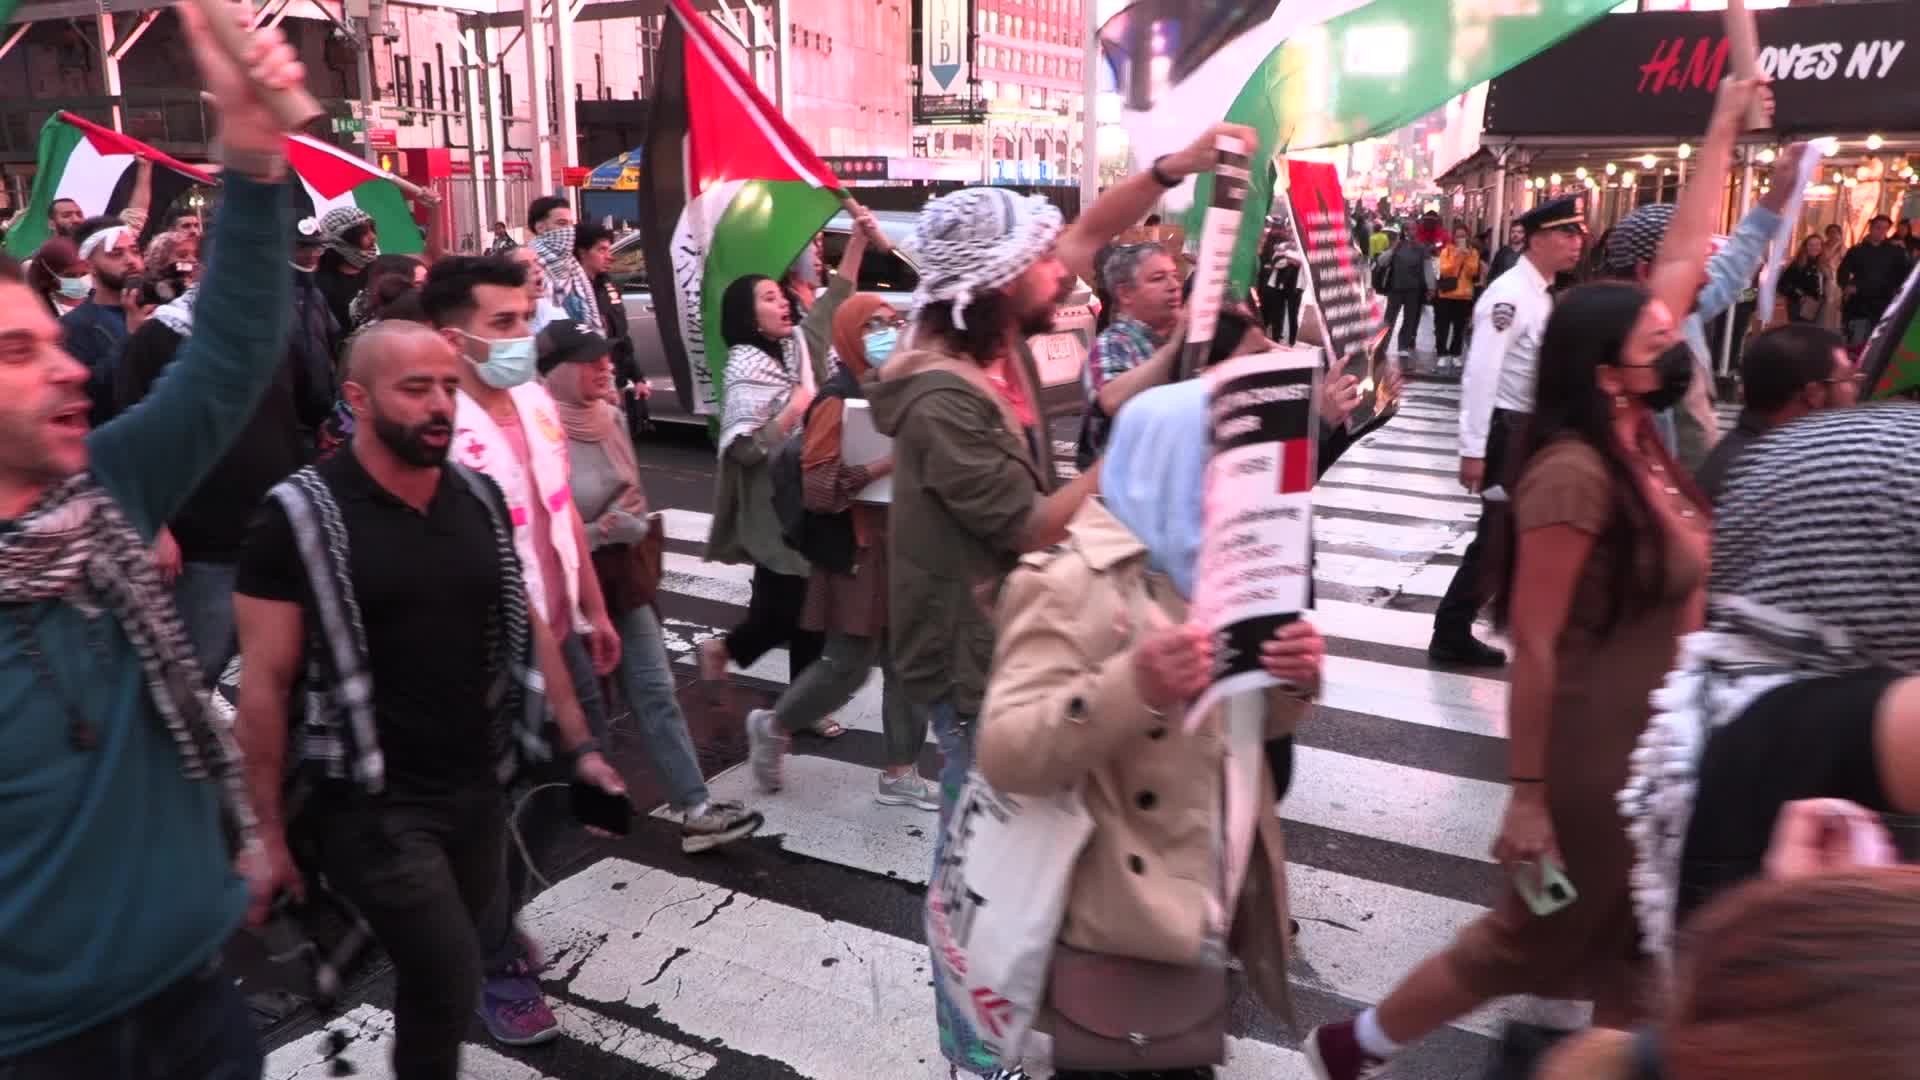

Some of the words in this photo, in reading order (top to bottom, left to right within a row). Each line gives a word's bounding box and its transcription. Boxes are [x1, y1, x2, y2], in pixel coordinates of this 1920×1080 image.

[1638, 36, 1730, 94] H&M
[1758, 42, 1843, 81] OVES
[1845, 39, 1905, 80] NY
